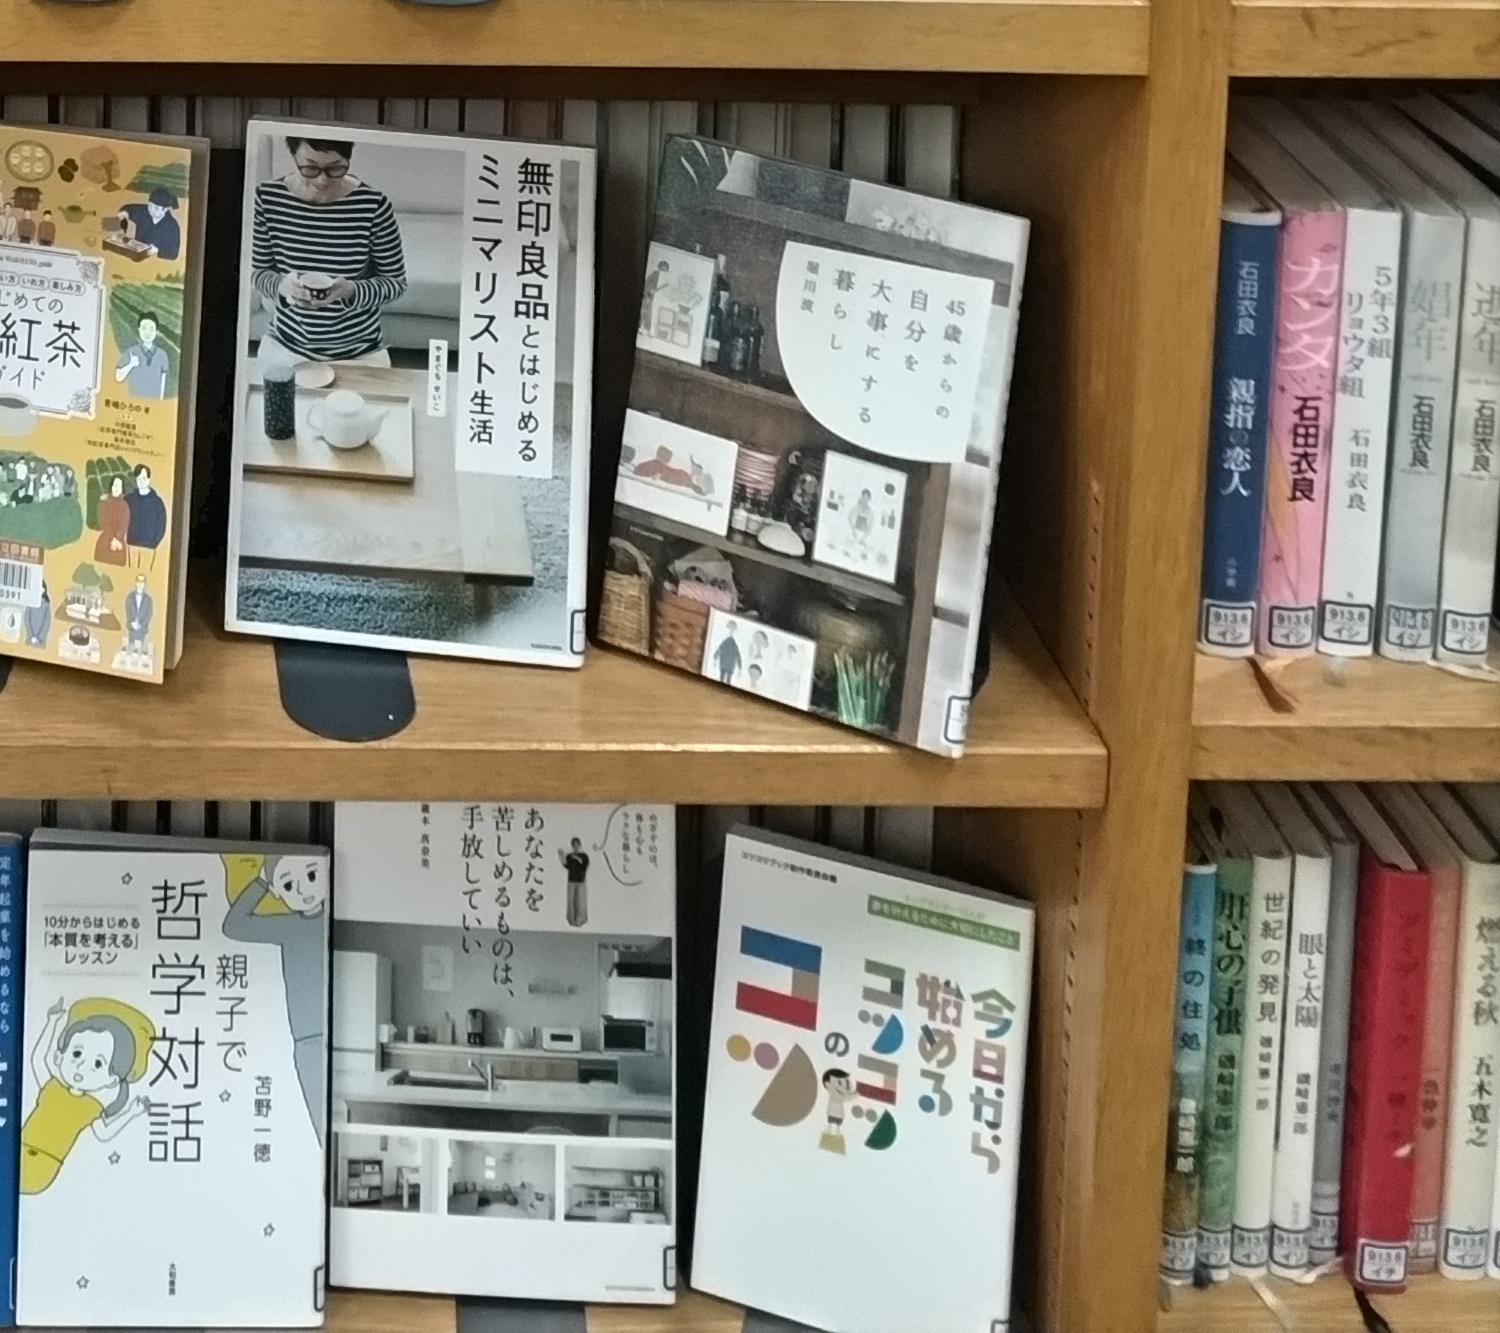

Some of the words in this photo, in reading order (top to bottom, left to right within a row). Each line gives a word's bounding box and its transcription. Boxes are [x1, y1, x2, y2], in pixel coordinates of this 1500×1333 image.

[467, 152, 503, 447] ミニマリスト生活
[512, 156, 555, 464] 無印良品とはじめる
[827, 266, 857, 352] 暮らし
[857, 277, 894, 425] 大事にする
[902, 287, 931, 374] 自分を
[1278, 257, 1340, 371] カンタ
[1339, 291, 1366, 398] リョウタ組
[1366, 265, 1397, 359] 5年3組
[1346, 428, 1371, 512] 石田衣良
[459, 804, 486, 957] 手放していい
[490, 805, 517, 998] 苦しめるものは、
[522, 806, 548, 913] あなたを
[43, 914, 142, 931] 10分からはじめる
[43, 931, 142, 952] 「本質を考える」
[63, 949, 119, 966] レッスン
[1256, 891, 1285, 1025] 世紀の発見
[148, 878, 209, 1164] 哲学対話
[214, 953, 250, 1074] 親子で
[1294, 933, 1324, 1030] 眼と太陽
[916, 972, 965, 1119] 始める
